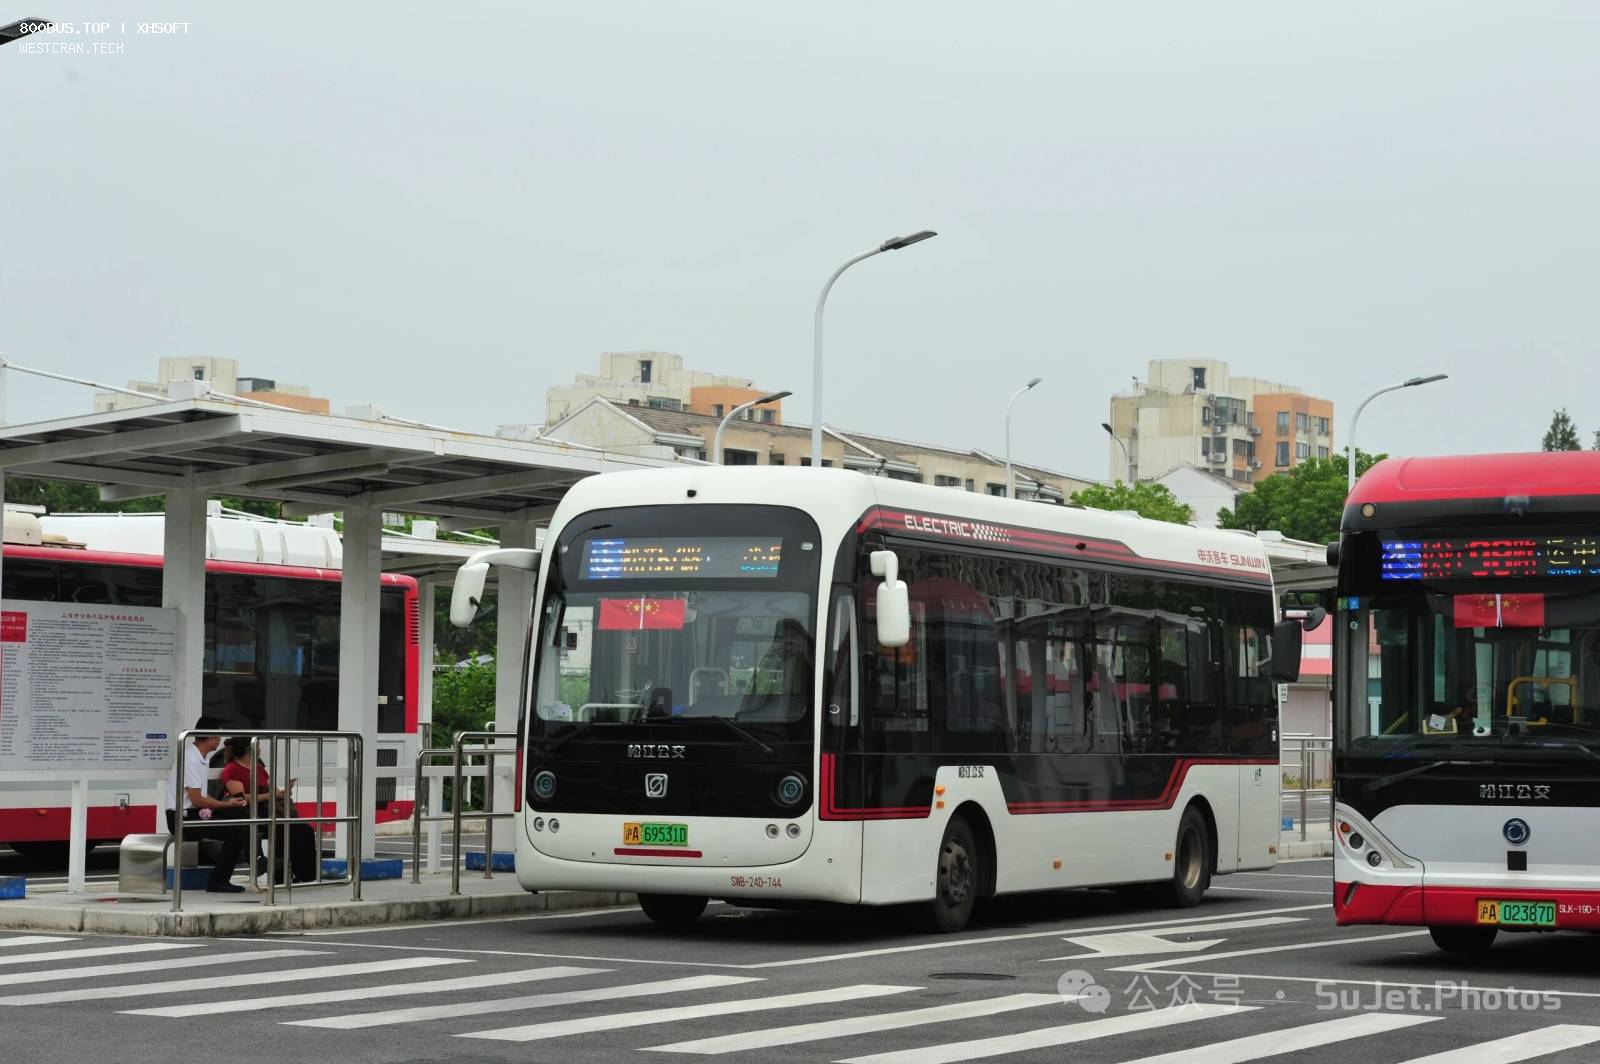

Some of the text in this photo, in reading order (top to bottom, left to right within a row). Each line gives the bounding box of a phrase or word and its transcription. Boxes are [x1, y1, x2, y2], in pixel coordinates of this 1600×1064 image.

[904, 514, 971, 537] ELECTRIC
[1230, 554, 1266, 569] SUNWIN
[627, 744, 686, 758] 松江公交
[1479, 784, 1551, 799] 松江公交
[730, 875, 782, 888] SWB-24D-744
